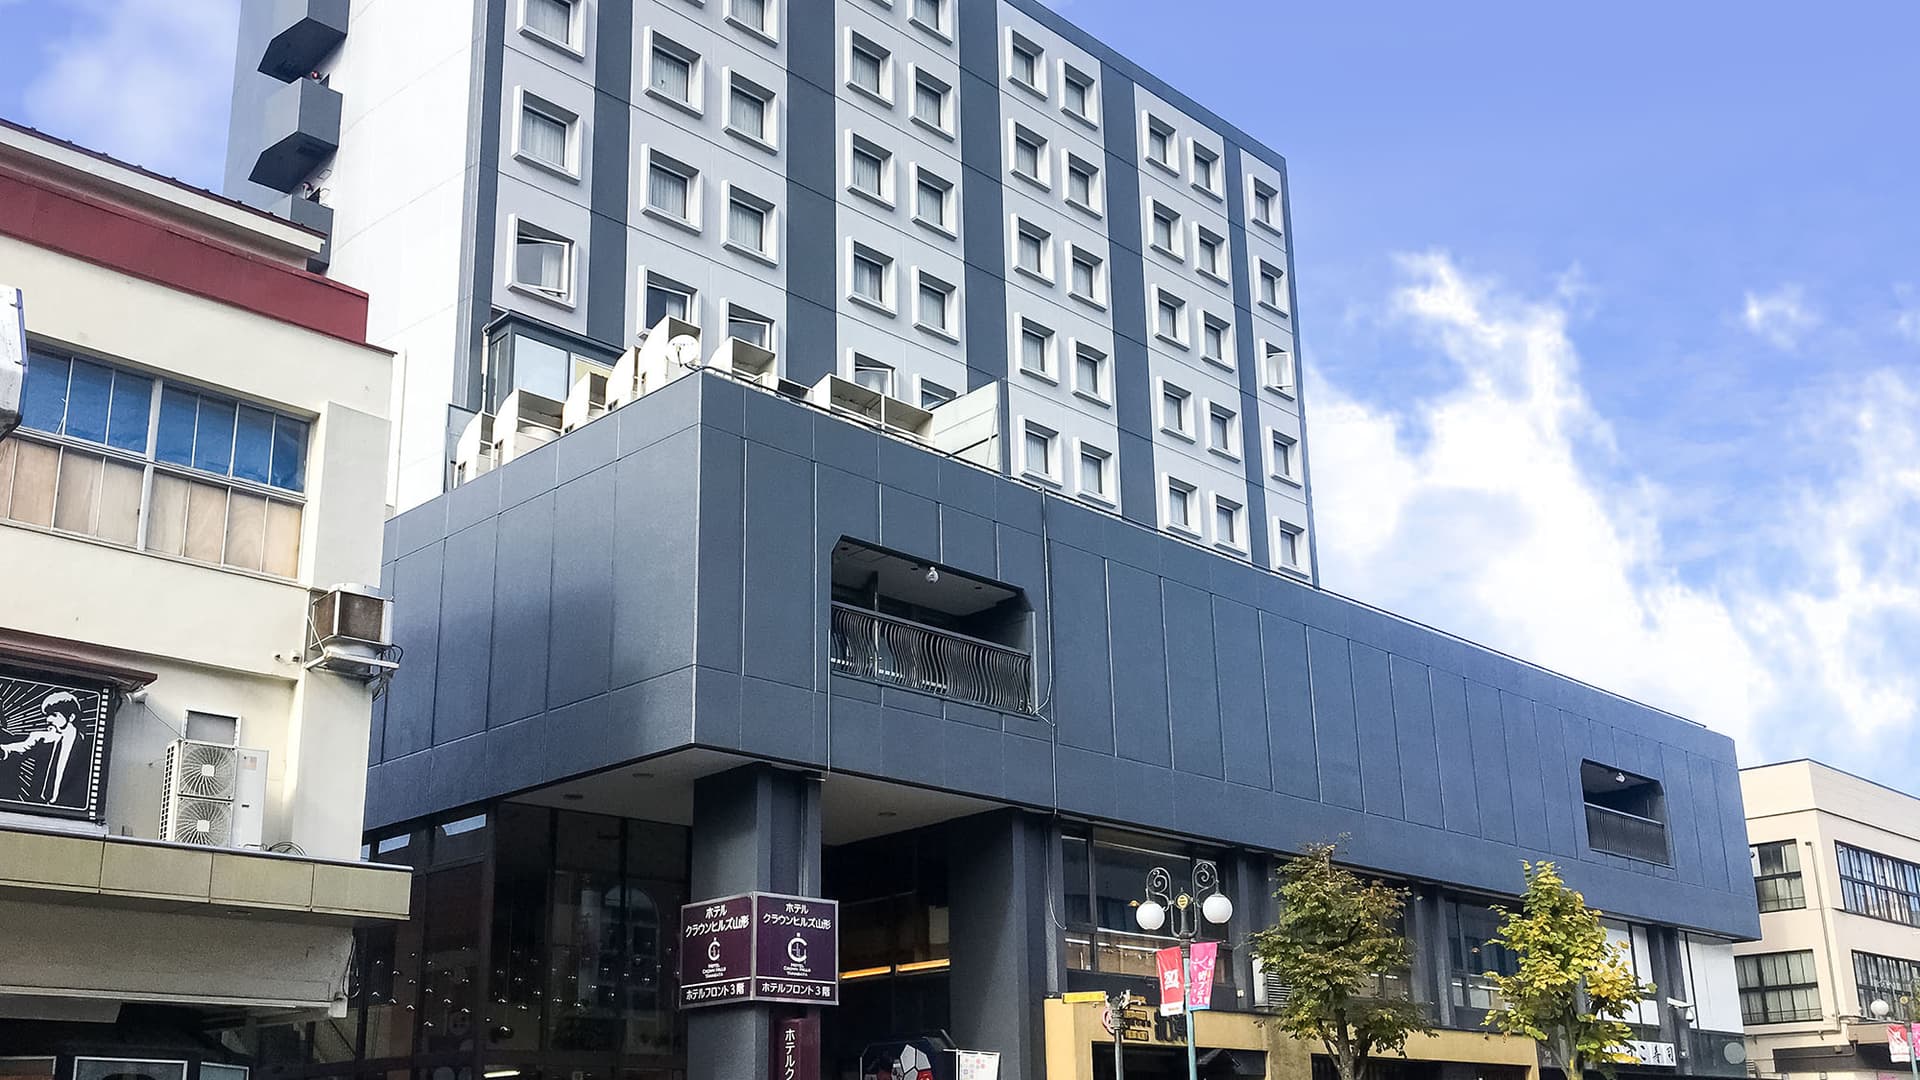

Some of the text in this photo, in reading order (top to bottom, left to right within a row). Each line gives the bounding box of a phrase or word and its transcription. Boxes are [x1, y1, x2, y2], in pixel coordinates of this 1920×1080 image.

[705, 904, 727, 918] ホテル
[785, 903, 809, 914] ホテル
[685, 914, 750, 937] クラウンヒルズ山形
[763, 913, 832, 930] クラウンヒルズ山形
[686, 983, 745, 1000] ホテルフロント3階
[762, 983, 831, 998] ホテルフロント3階
[784, 1028, 796, 1080] ホテルク
